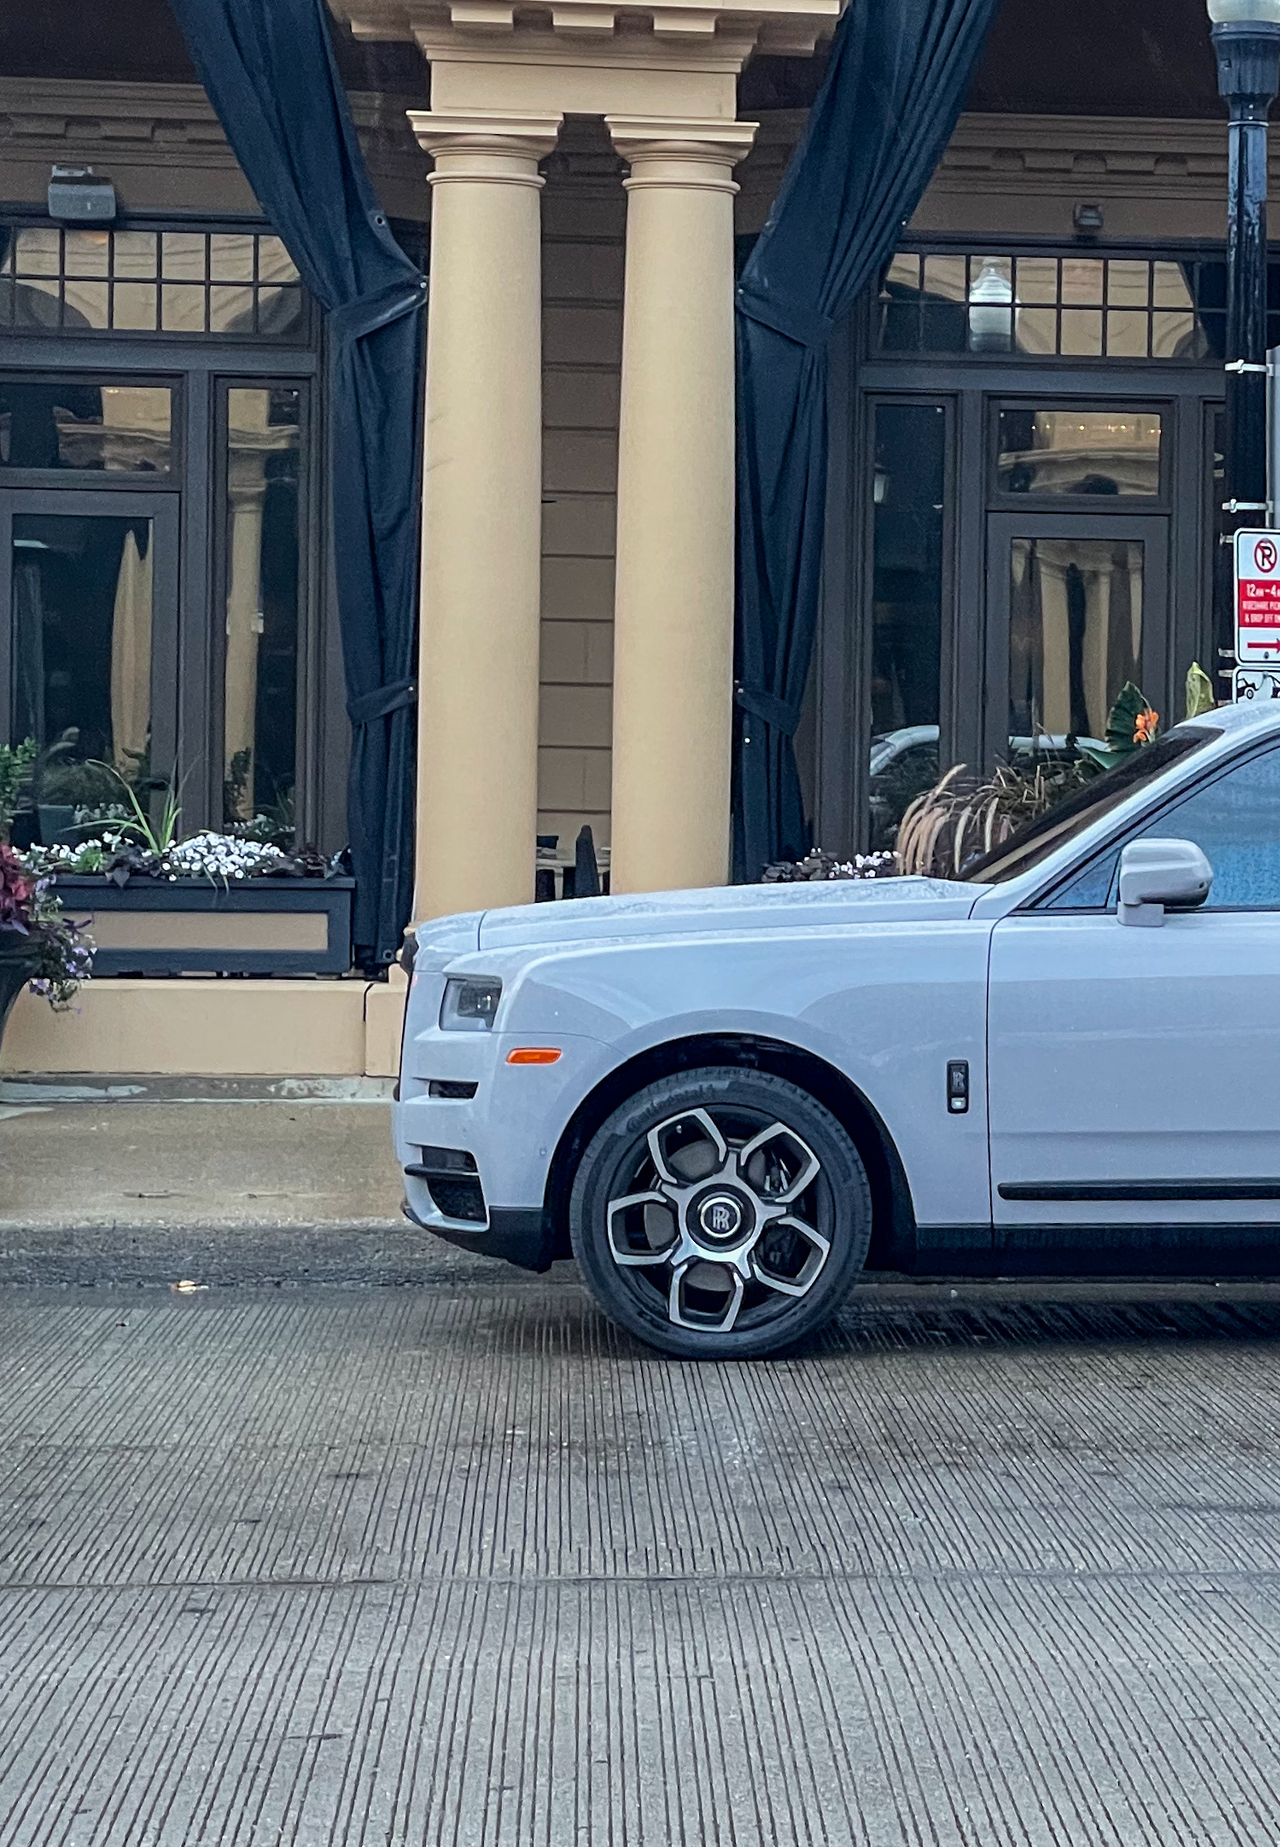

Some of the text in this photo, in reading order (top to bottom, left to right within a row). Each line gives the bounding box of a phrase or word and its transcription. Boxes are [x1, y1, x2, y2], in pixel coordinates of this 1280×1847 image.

[1269, 601, 1280, 611] PICK
[1250, 613, 1263, 623] DROP
[1264, 613, 1273, 623] OFF
